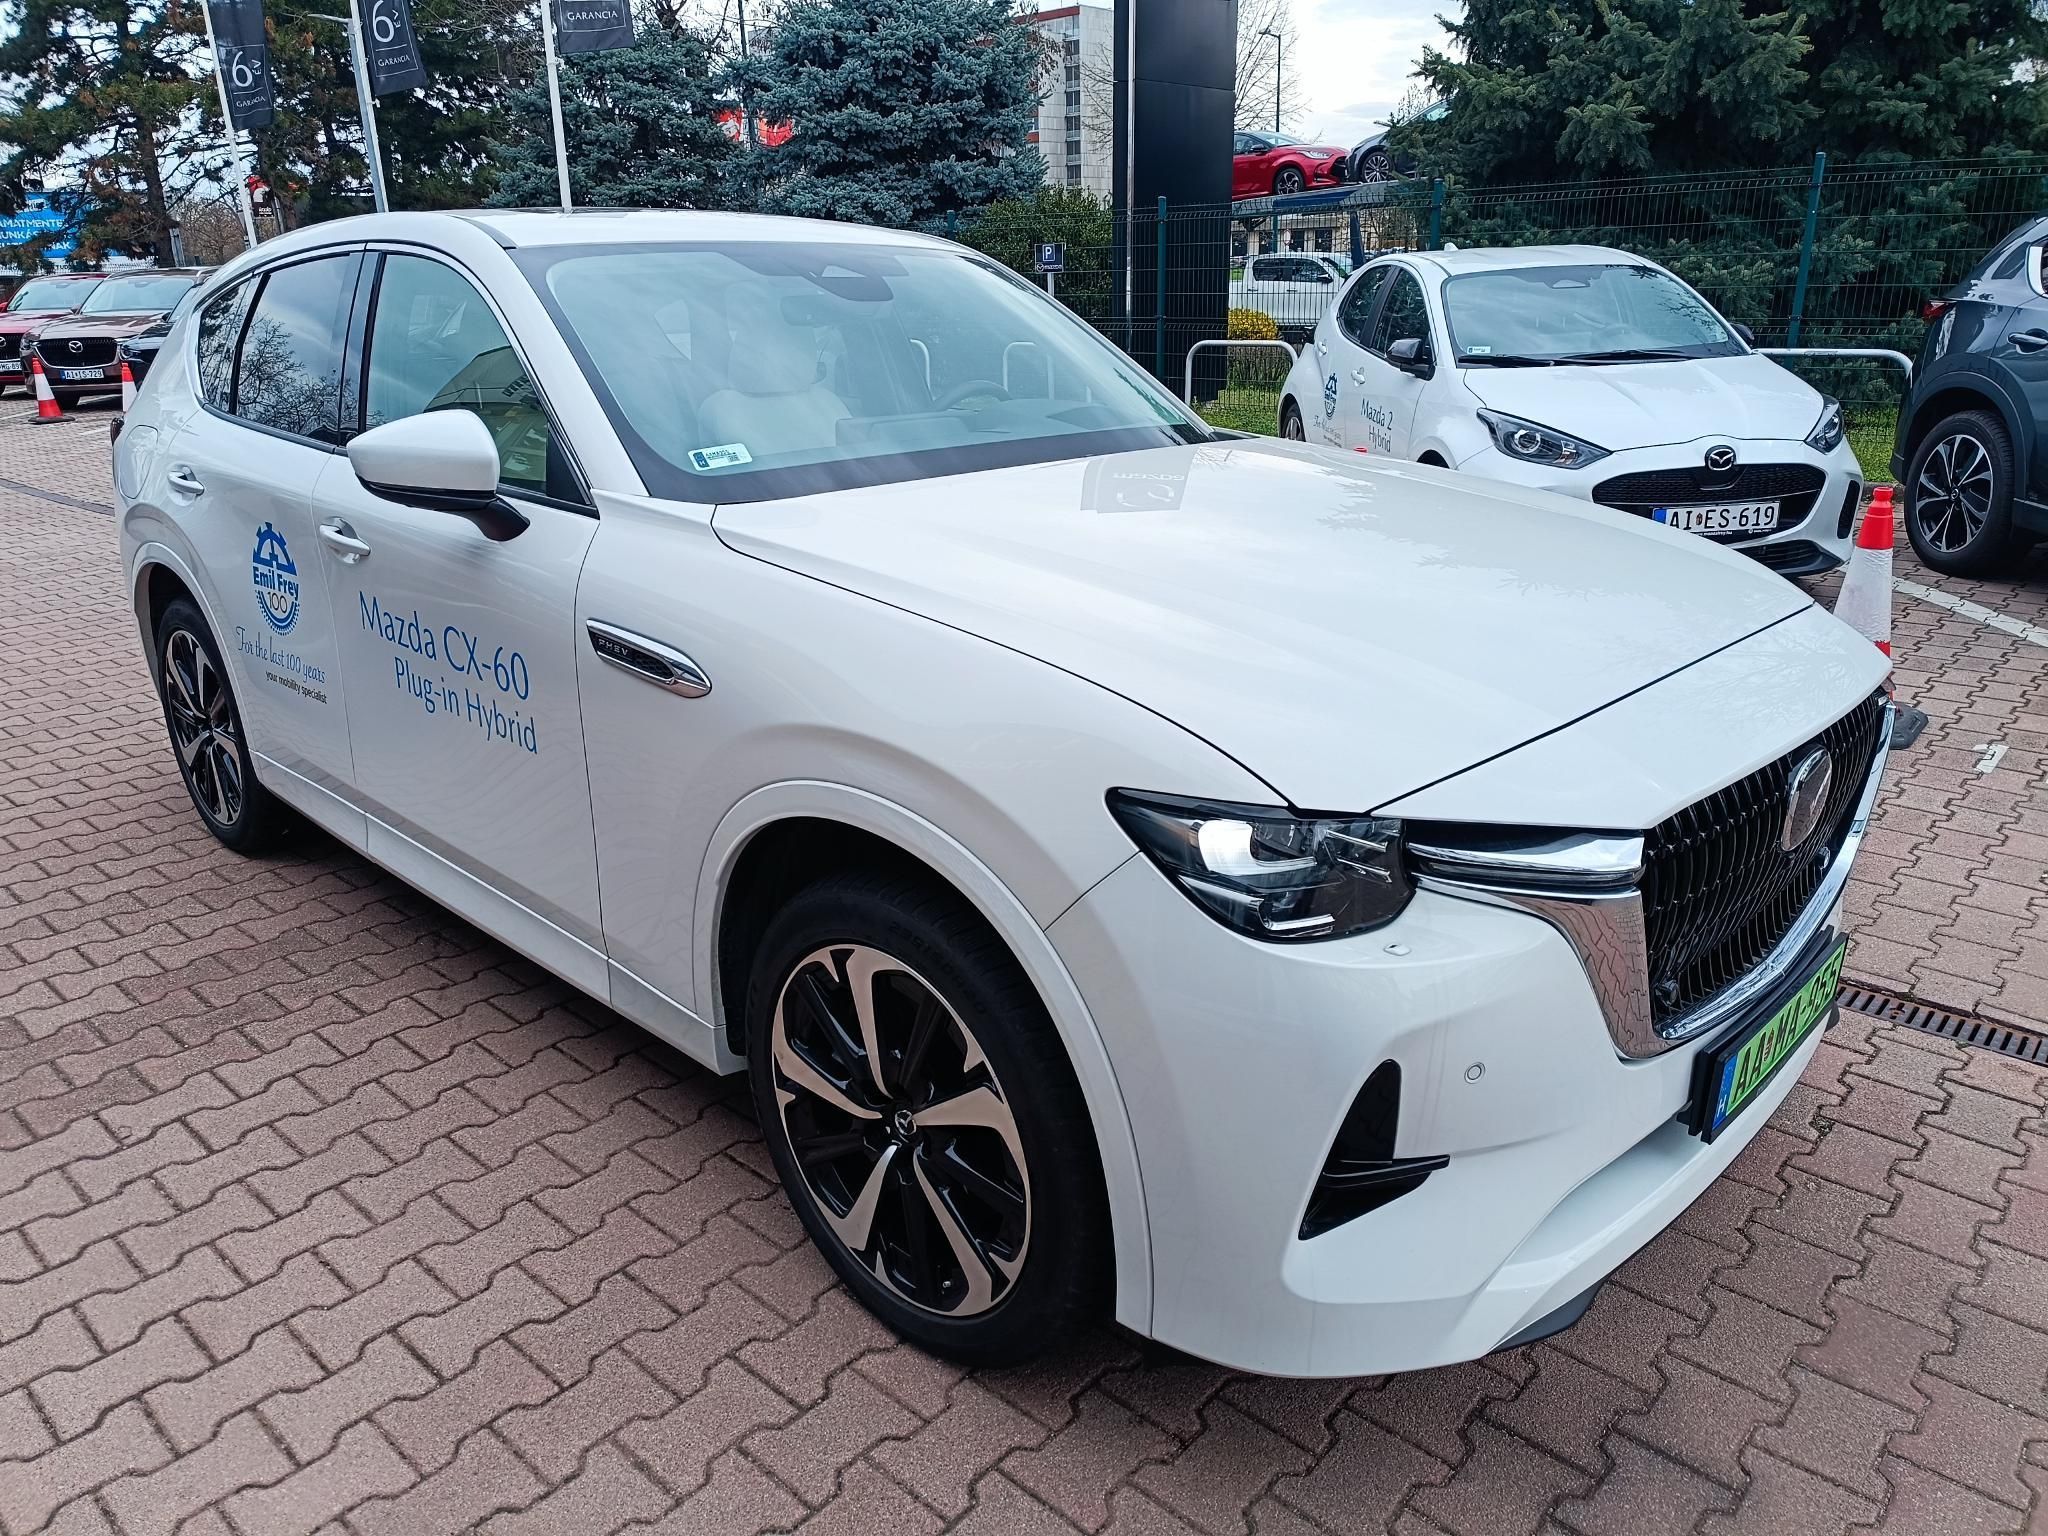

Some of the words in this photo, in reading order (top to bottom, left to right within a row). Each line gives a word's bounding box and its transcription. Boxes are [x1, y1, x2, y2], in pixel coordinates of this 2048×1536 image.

[371, 0, 394, 43] 6
[567, 10, 618, 21] GARANCIA
[232, 51, 253, 87] 6
[377, 54, 410, 67] GARANCIA
[1045, 246, 1053, 260] P
[1361, 398, 1385, 427] Mazda
[1387, 411, 1393, 431] 2
[1368, 424, 1392, 453] Hybrid
[1704, 506, 1775, 529] ES-619
[253, 565, 276, 590] Emil
[277, 573, 299, 601] Frey
[267, 591, 288, 614] 100
[235, 626, 254, 656] For
[255, 632, 268, 661] the
[269, 636, 285, 668] last
[286, 652, 301, 674] 100
[302, 661, 326, 684] years
[359, 590, 437, 661] Mazda
[443, 625, 529, 700] CX-60
[599, 638, 628, 656] PHEV
[265, 671, 278, 683] your
[278, 675, 301, 695] mobility
[301, 684, 328, 704] specialist
[394, 656, 460, 714] Plug-in
[464, 687, 538, 755] Hybrid
